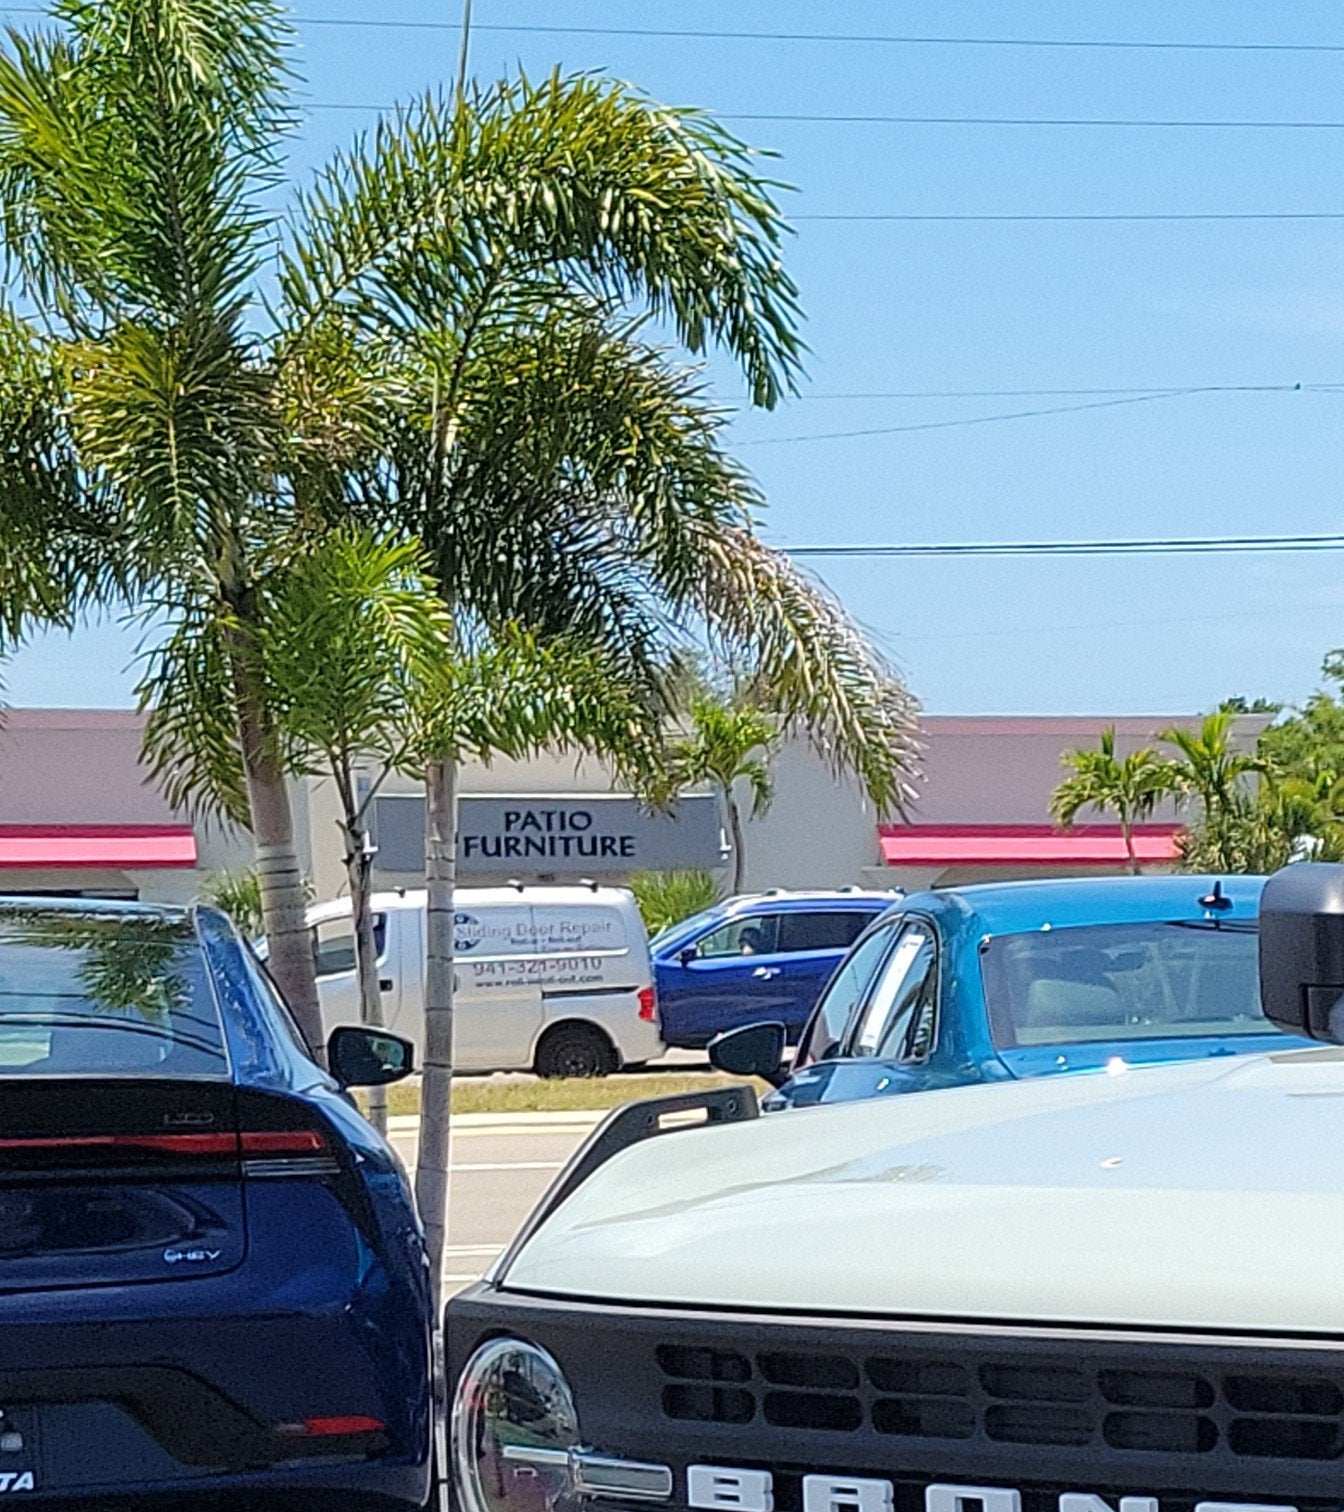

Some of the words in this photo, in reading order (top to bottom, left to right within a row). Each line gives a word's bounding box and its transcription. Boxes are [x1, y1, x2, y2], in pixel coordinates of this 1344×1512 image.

[505, 810, 592, 832] PATIO
[464, 835, 637, 858] FURNITURE
[456, 923, 512, 940] Sliding
[516, 921, 554, 937] Door
[560, 919, 612, 936] Repair
